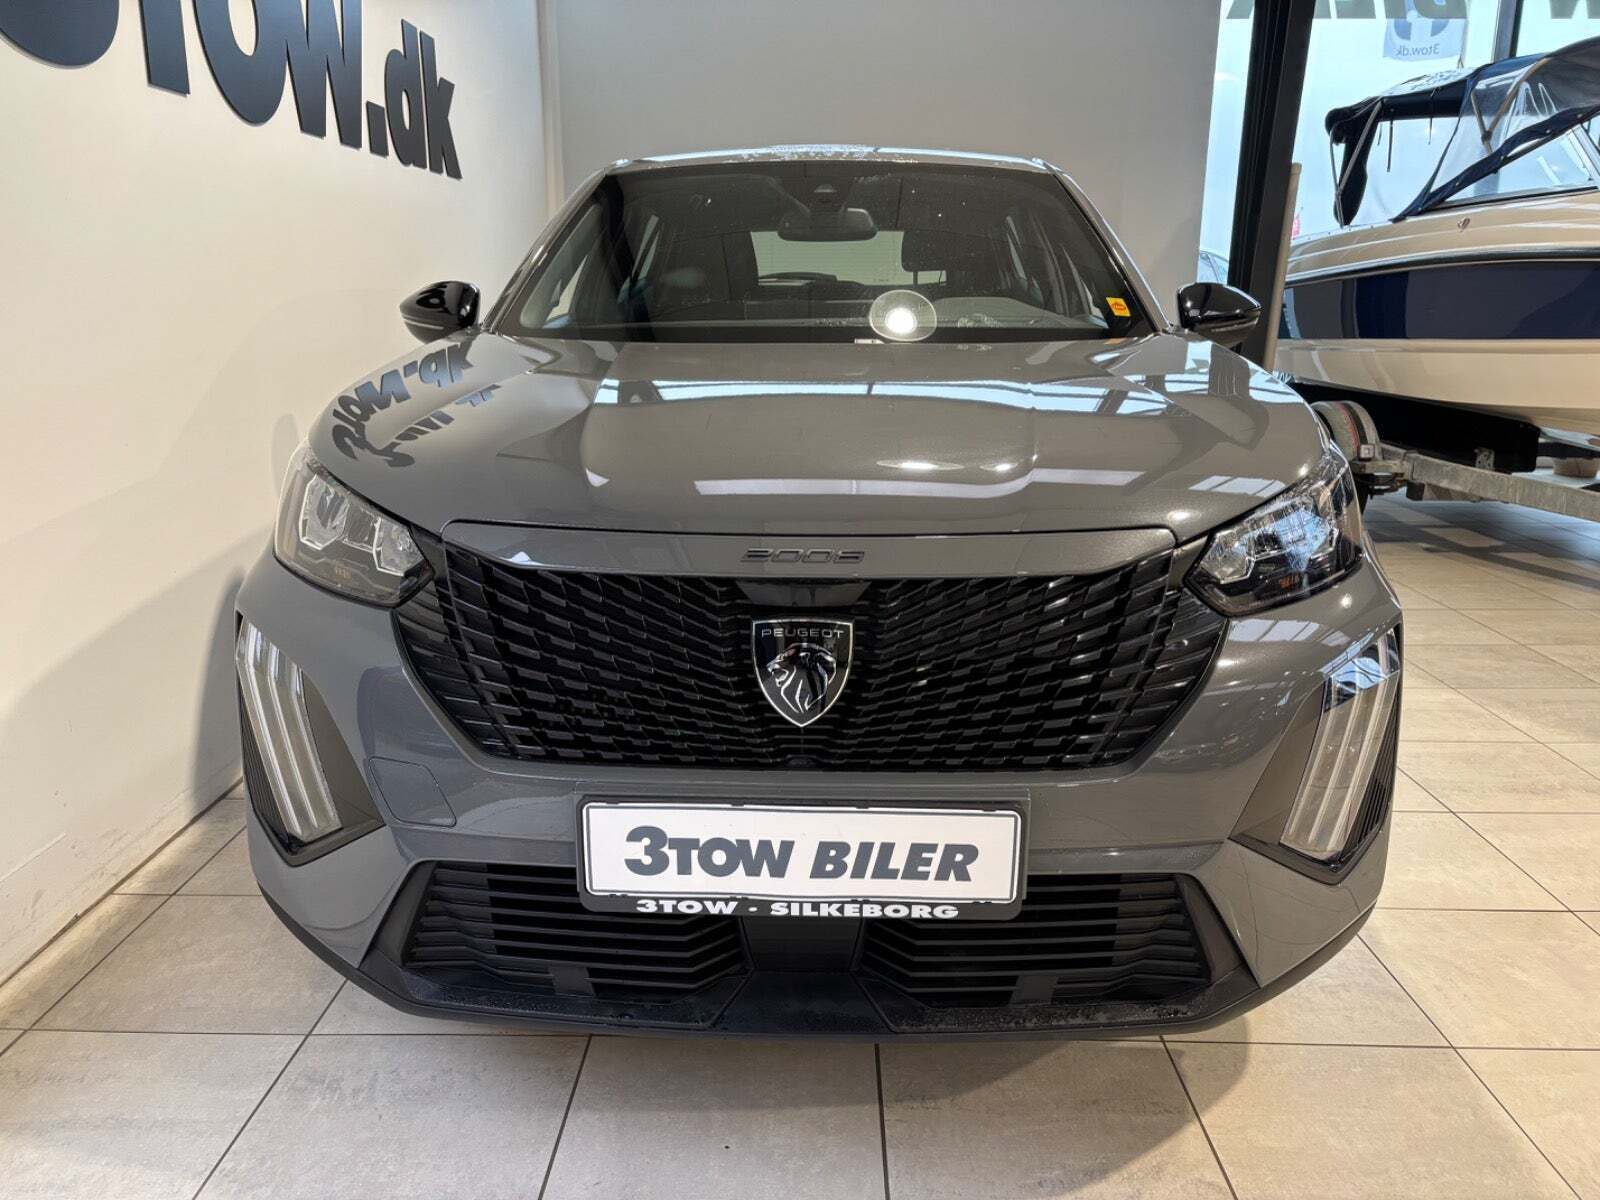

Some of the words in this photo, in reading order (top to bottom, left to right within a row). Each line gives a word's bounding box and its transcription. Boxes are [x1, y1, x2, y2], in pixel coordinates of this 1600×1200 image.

[740, 548, 865, 564] 2008
[761, 627, 845, 638] PEUGEOT
[624, 825, 795, 878] 3TOW
[809, 840, 979, 882] BILER
[636, 900, 738, 915] 3TOW
[770, 902, 959, 919] SILKEBORG
